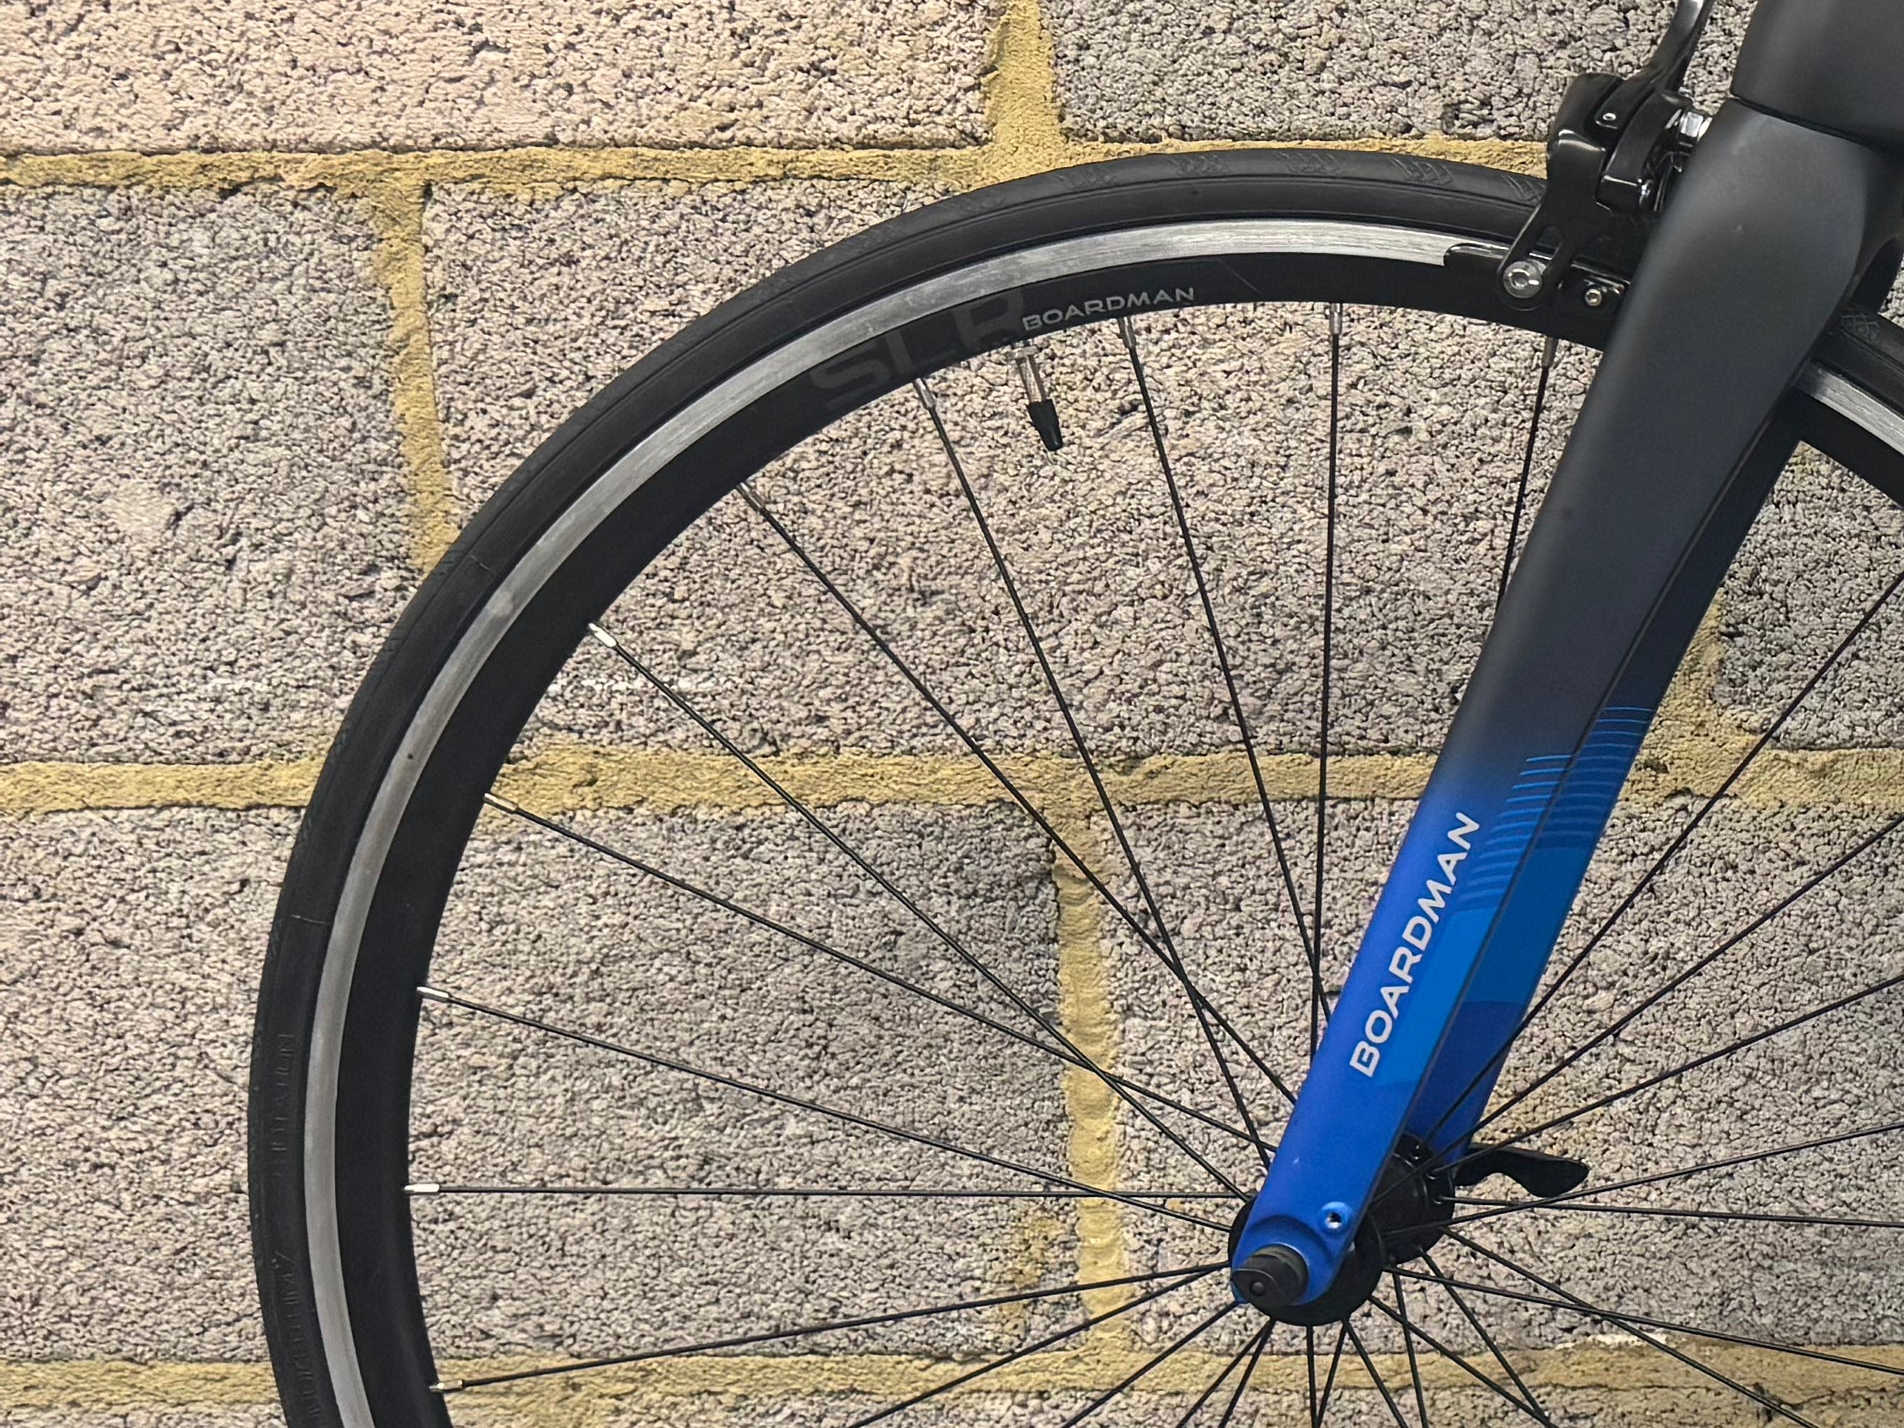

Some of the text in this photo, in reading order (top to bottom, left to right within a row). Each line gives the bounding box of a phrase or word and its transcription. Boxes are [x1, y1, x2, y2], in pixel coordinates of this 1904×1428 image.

[810, 286, 1195, 410] SLR BOARDMAN
[1349, 812, 1481, 1078] BOARDMAN
